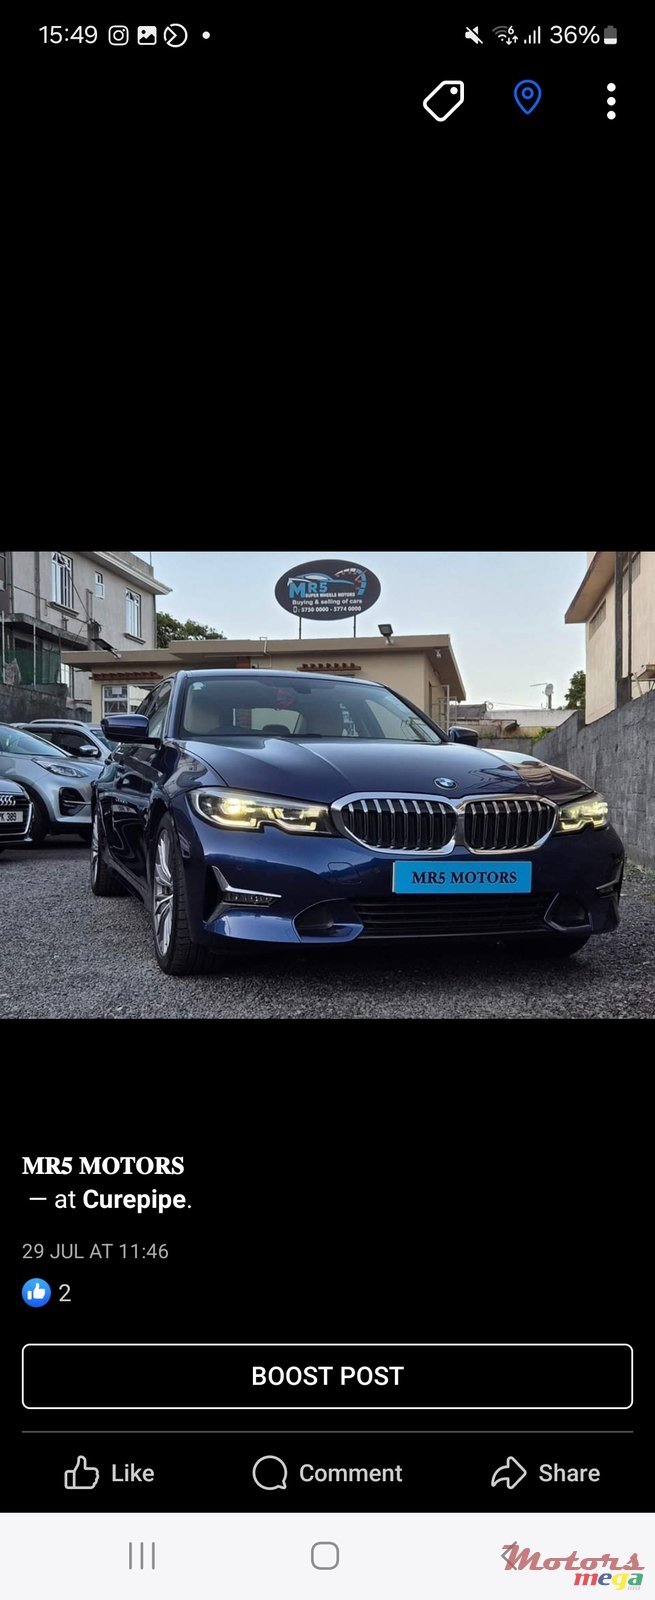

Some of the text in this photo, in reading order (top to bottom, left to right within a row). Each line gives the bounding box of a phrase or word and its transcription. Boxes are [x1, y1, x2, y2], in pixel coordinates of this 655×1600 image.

[39, 26, 97, 44] 15:49
[550, 26, 600, 44] 36%
[289, 581, 328, 598] MR5
[412, 872, 517, 884] MR5 MOTORS
[22, 1157, 184, 1175] MR5 MOTORS
[55, 1190, 76, 1209] at
[83, 1189, 191, 1213] Curepipe.
[22, 1244, 169, 1259] 29 JUL AT 11:46
[59, 1284, 71, 1301] 2
[252, 1366, 404, 1385] BOOST POST
[112, 1463, 155, 1482] Like
[299, 1464, 402, 1482] Comment
[539, 1463, 601, 1482] Share
